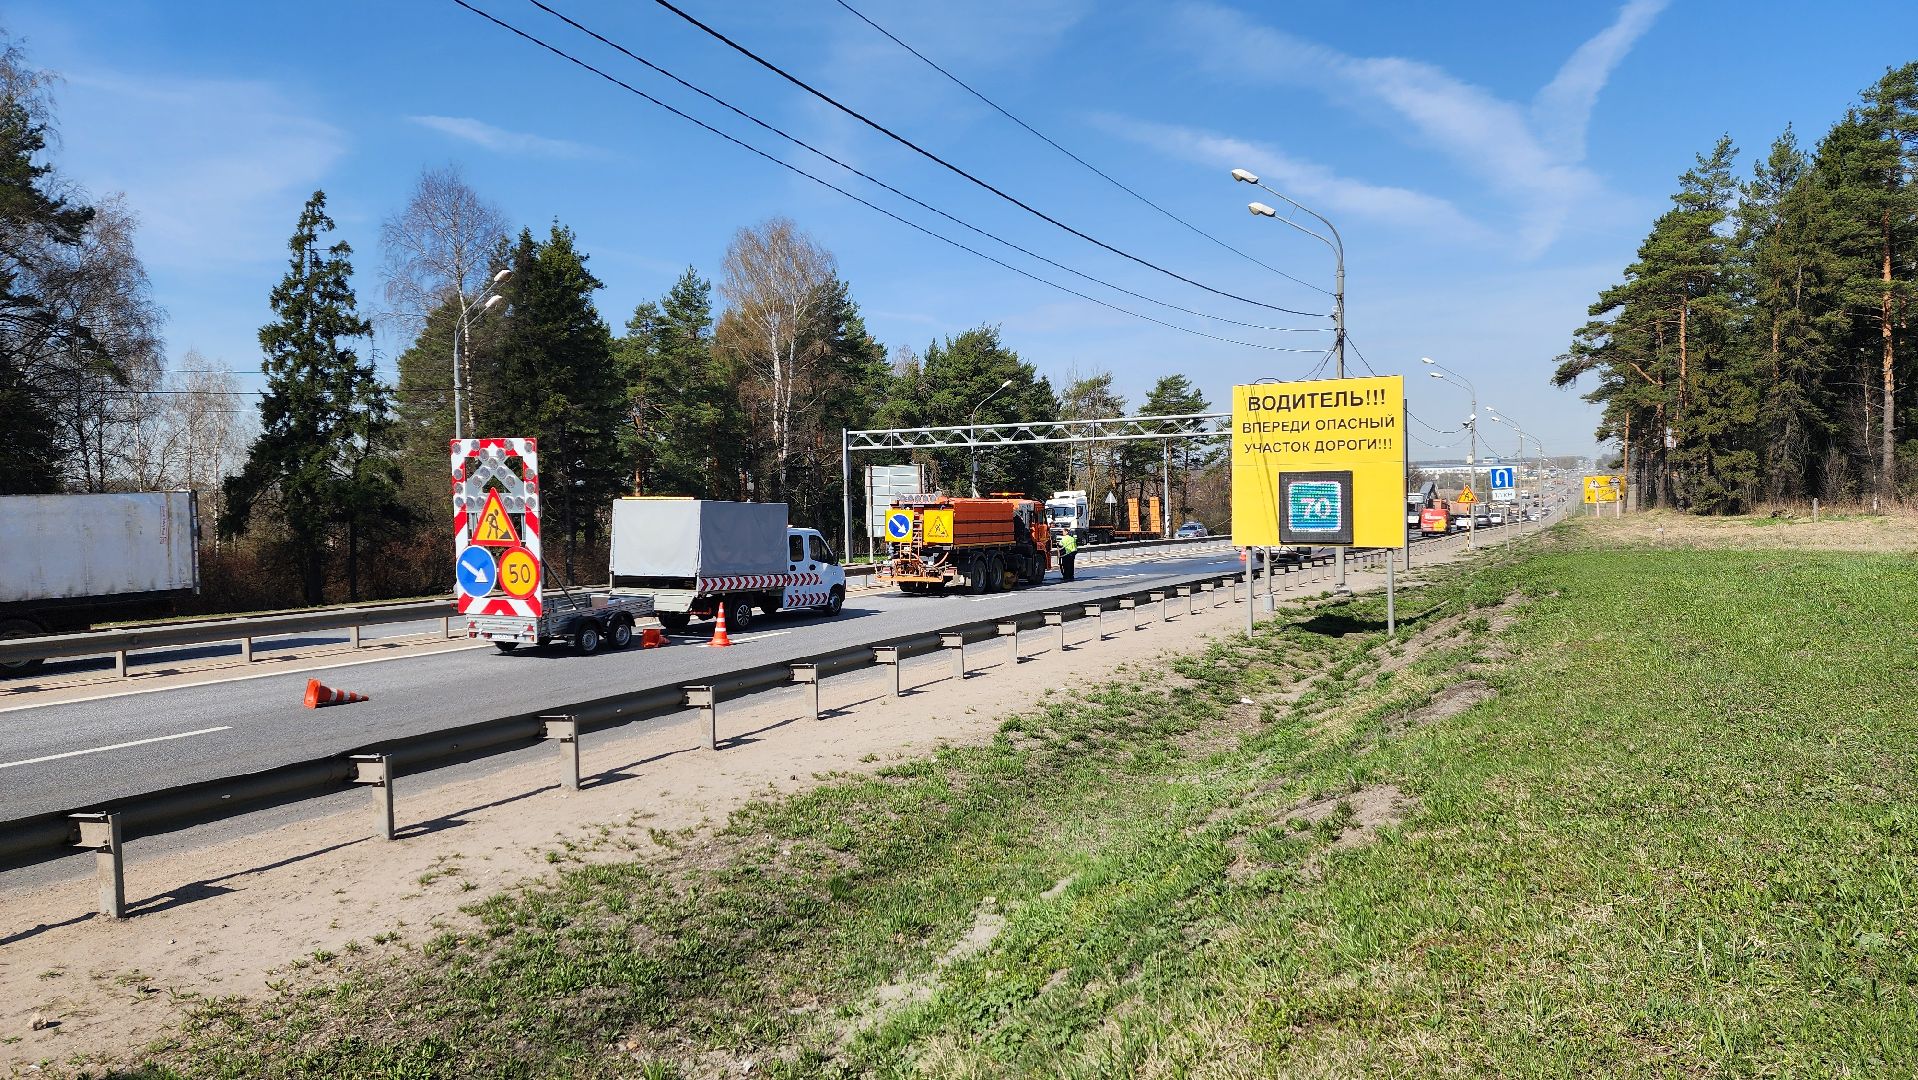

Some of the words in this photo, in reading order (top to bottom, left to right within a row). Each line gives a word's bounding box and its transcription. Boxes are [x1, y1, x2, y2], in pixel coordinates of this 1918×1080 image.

[1248, 388, 1386, 413] ВОДИТЕЛЬ!!!
[1242, 420, 1310, 434] ВПЕРЕДИ
[1315, 413, 1395, 431] ОПАСНЫЙ
[1244, 440, 1311, 454] УЧАСТОК
[1314, 438, 1392, 454] ДОРОГИ!!!
[1301, 497, 1331, 519] 70
[509, 563, 531, 584] 50
